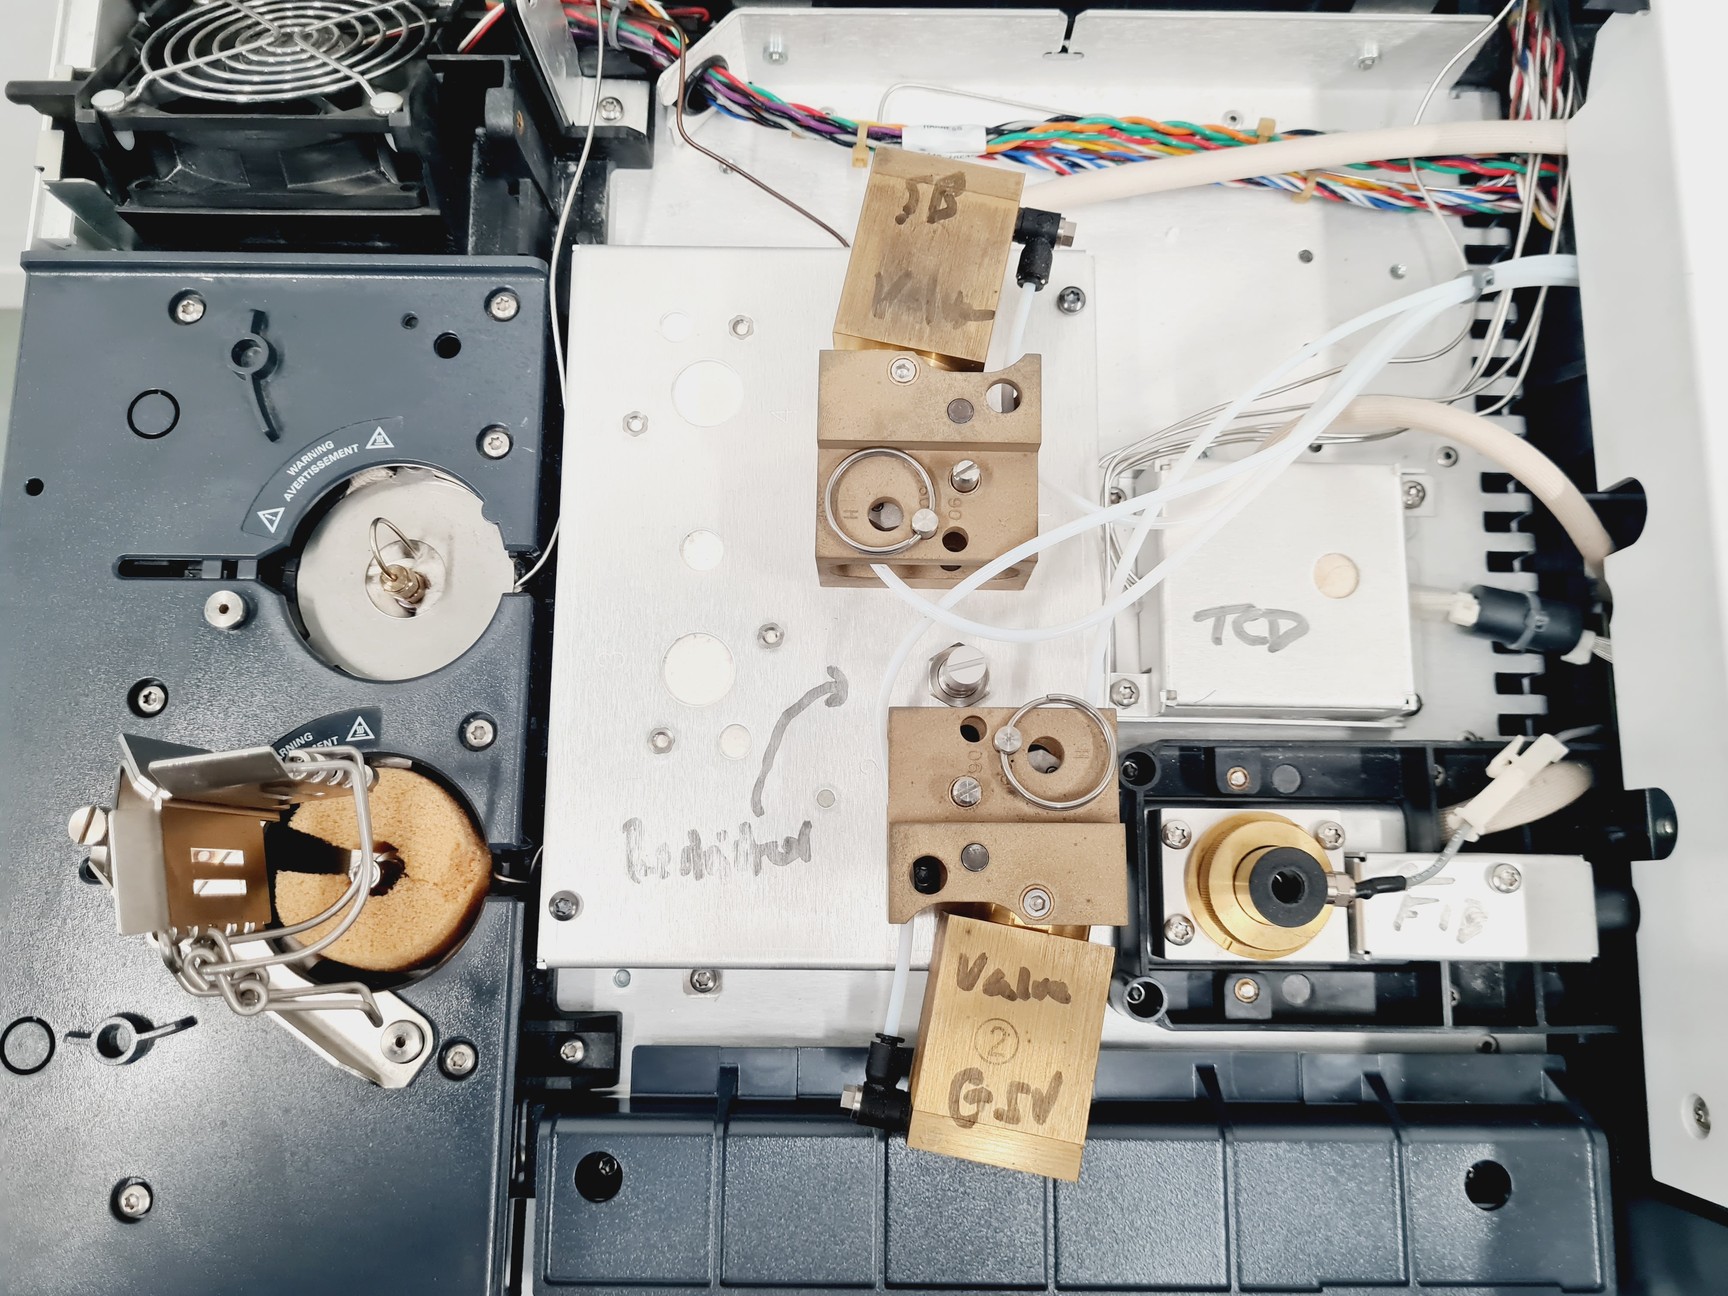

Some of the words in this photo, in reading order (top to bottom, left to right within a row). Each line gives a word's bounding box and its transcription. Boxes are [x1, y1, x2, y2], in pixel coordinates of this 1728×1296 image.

[283, 443, 359, 502] AVERTISSEMENT
[286, 440, 335, 476] WARNING
[1192, 602, 1311, 654] TCD
[278, 731, 314, 759] RNING
